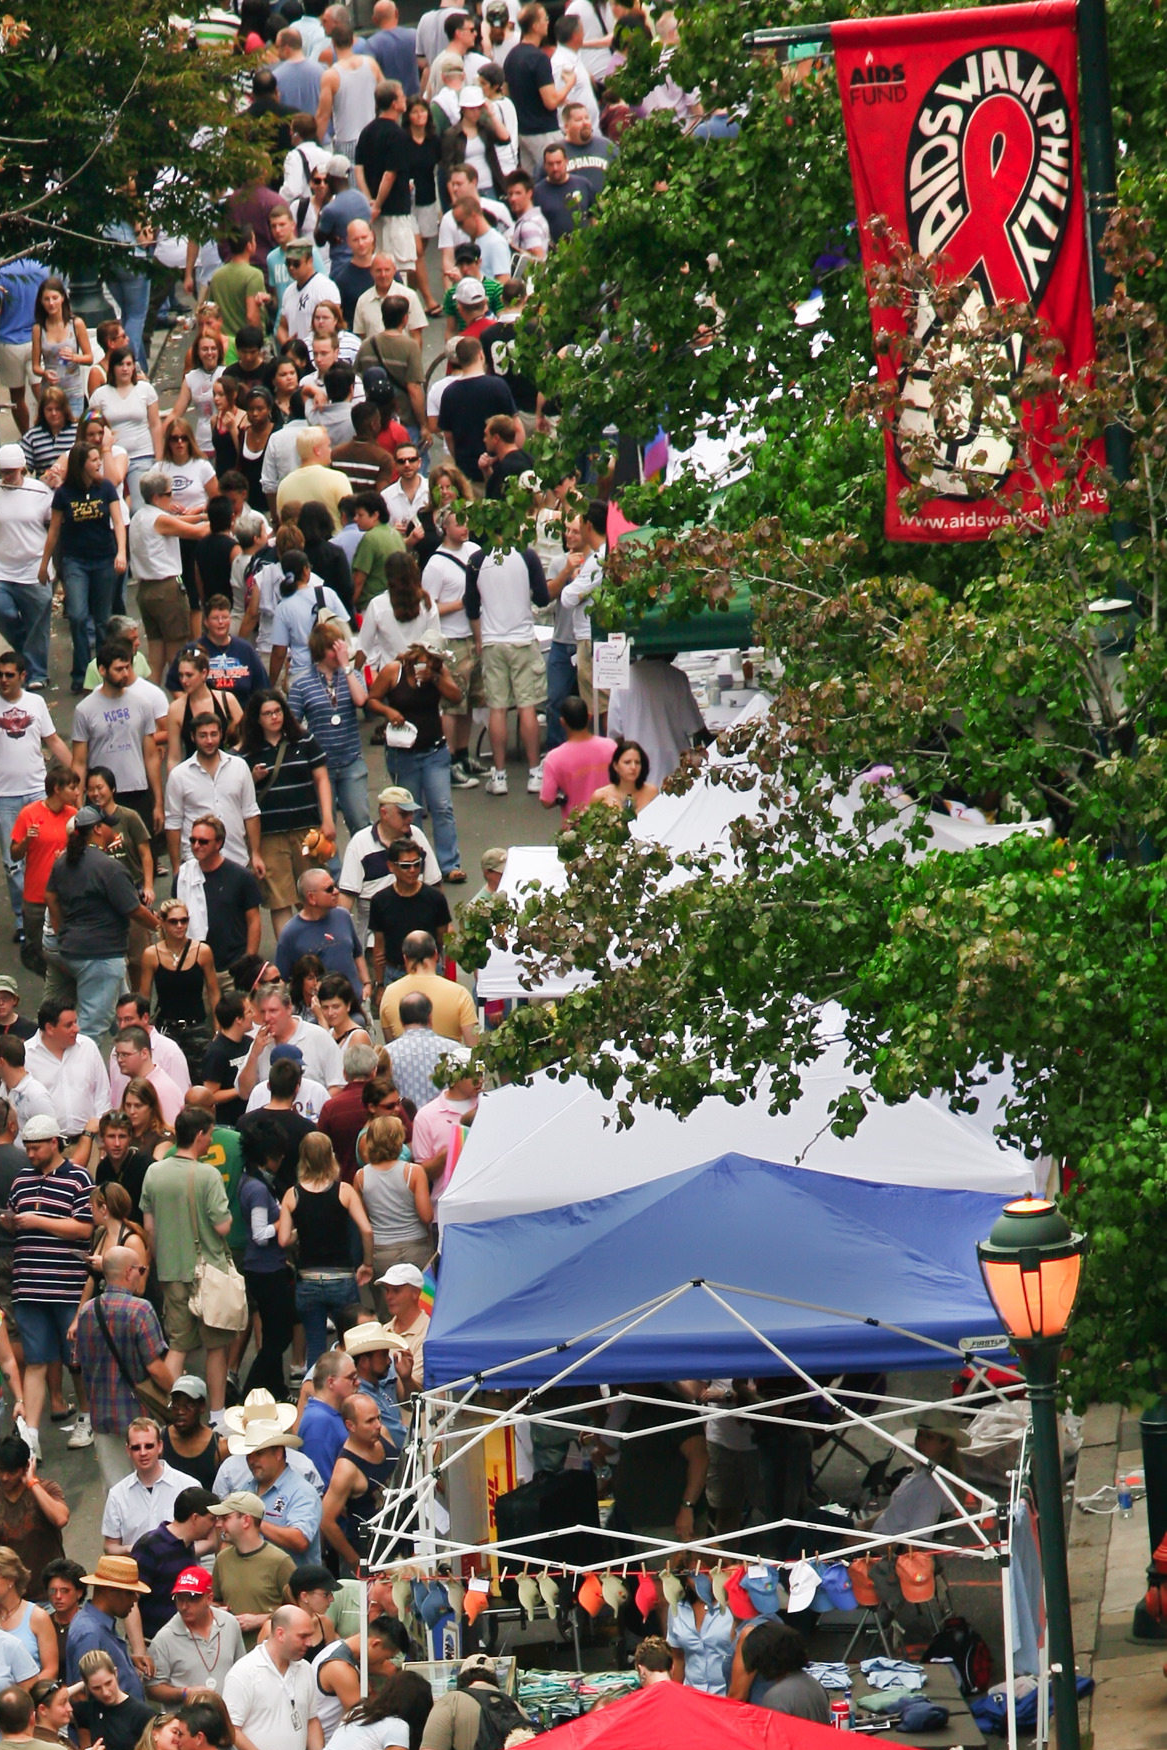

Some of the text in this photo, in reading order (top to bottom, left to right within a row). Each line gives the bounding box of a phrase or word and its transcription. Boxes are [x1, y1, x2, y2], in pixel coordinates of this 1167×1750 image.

[850, 62, 905, 86] AIDS
[849, 85, 907, 106] FUND
[909, 49, 1070, 292] AIDS WALK PHILLY
